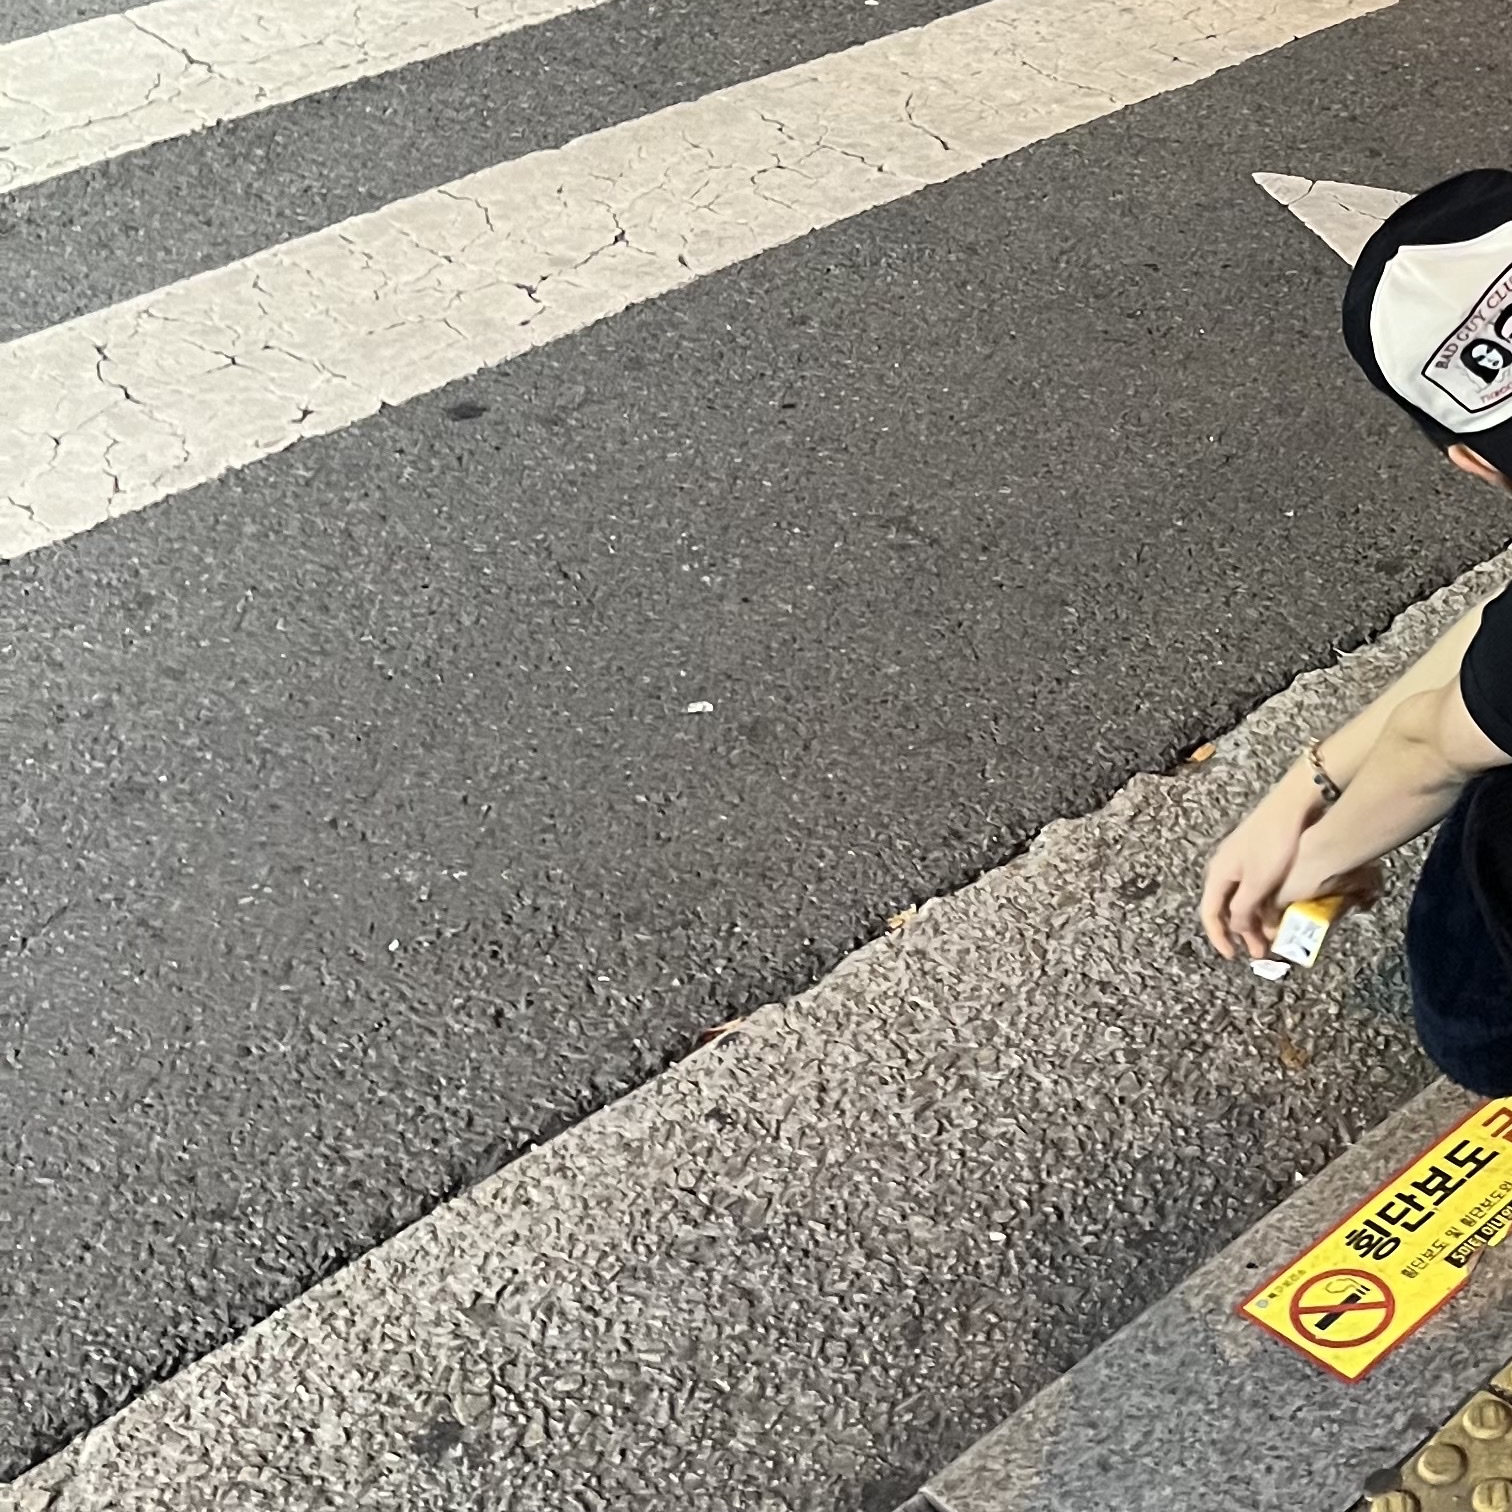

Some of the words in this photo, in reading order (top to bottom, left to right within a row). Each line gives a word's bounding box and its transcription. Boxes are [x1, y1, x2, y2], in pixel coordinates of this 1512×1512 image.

[1435, 343, 1458, 369] BAD
[1456, 310, 1486, 342] GUY
[1345, 1139, 1500, 1261] 횡단보도
[1401, 1238, 1449, 1279] 횡단보도
[1445, 1226, 1465, 1239] 및
[1451, 1230, 1488, 1264] 5미터
